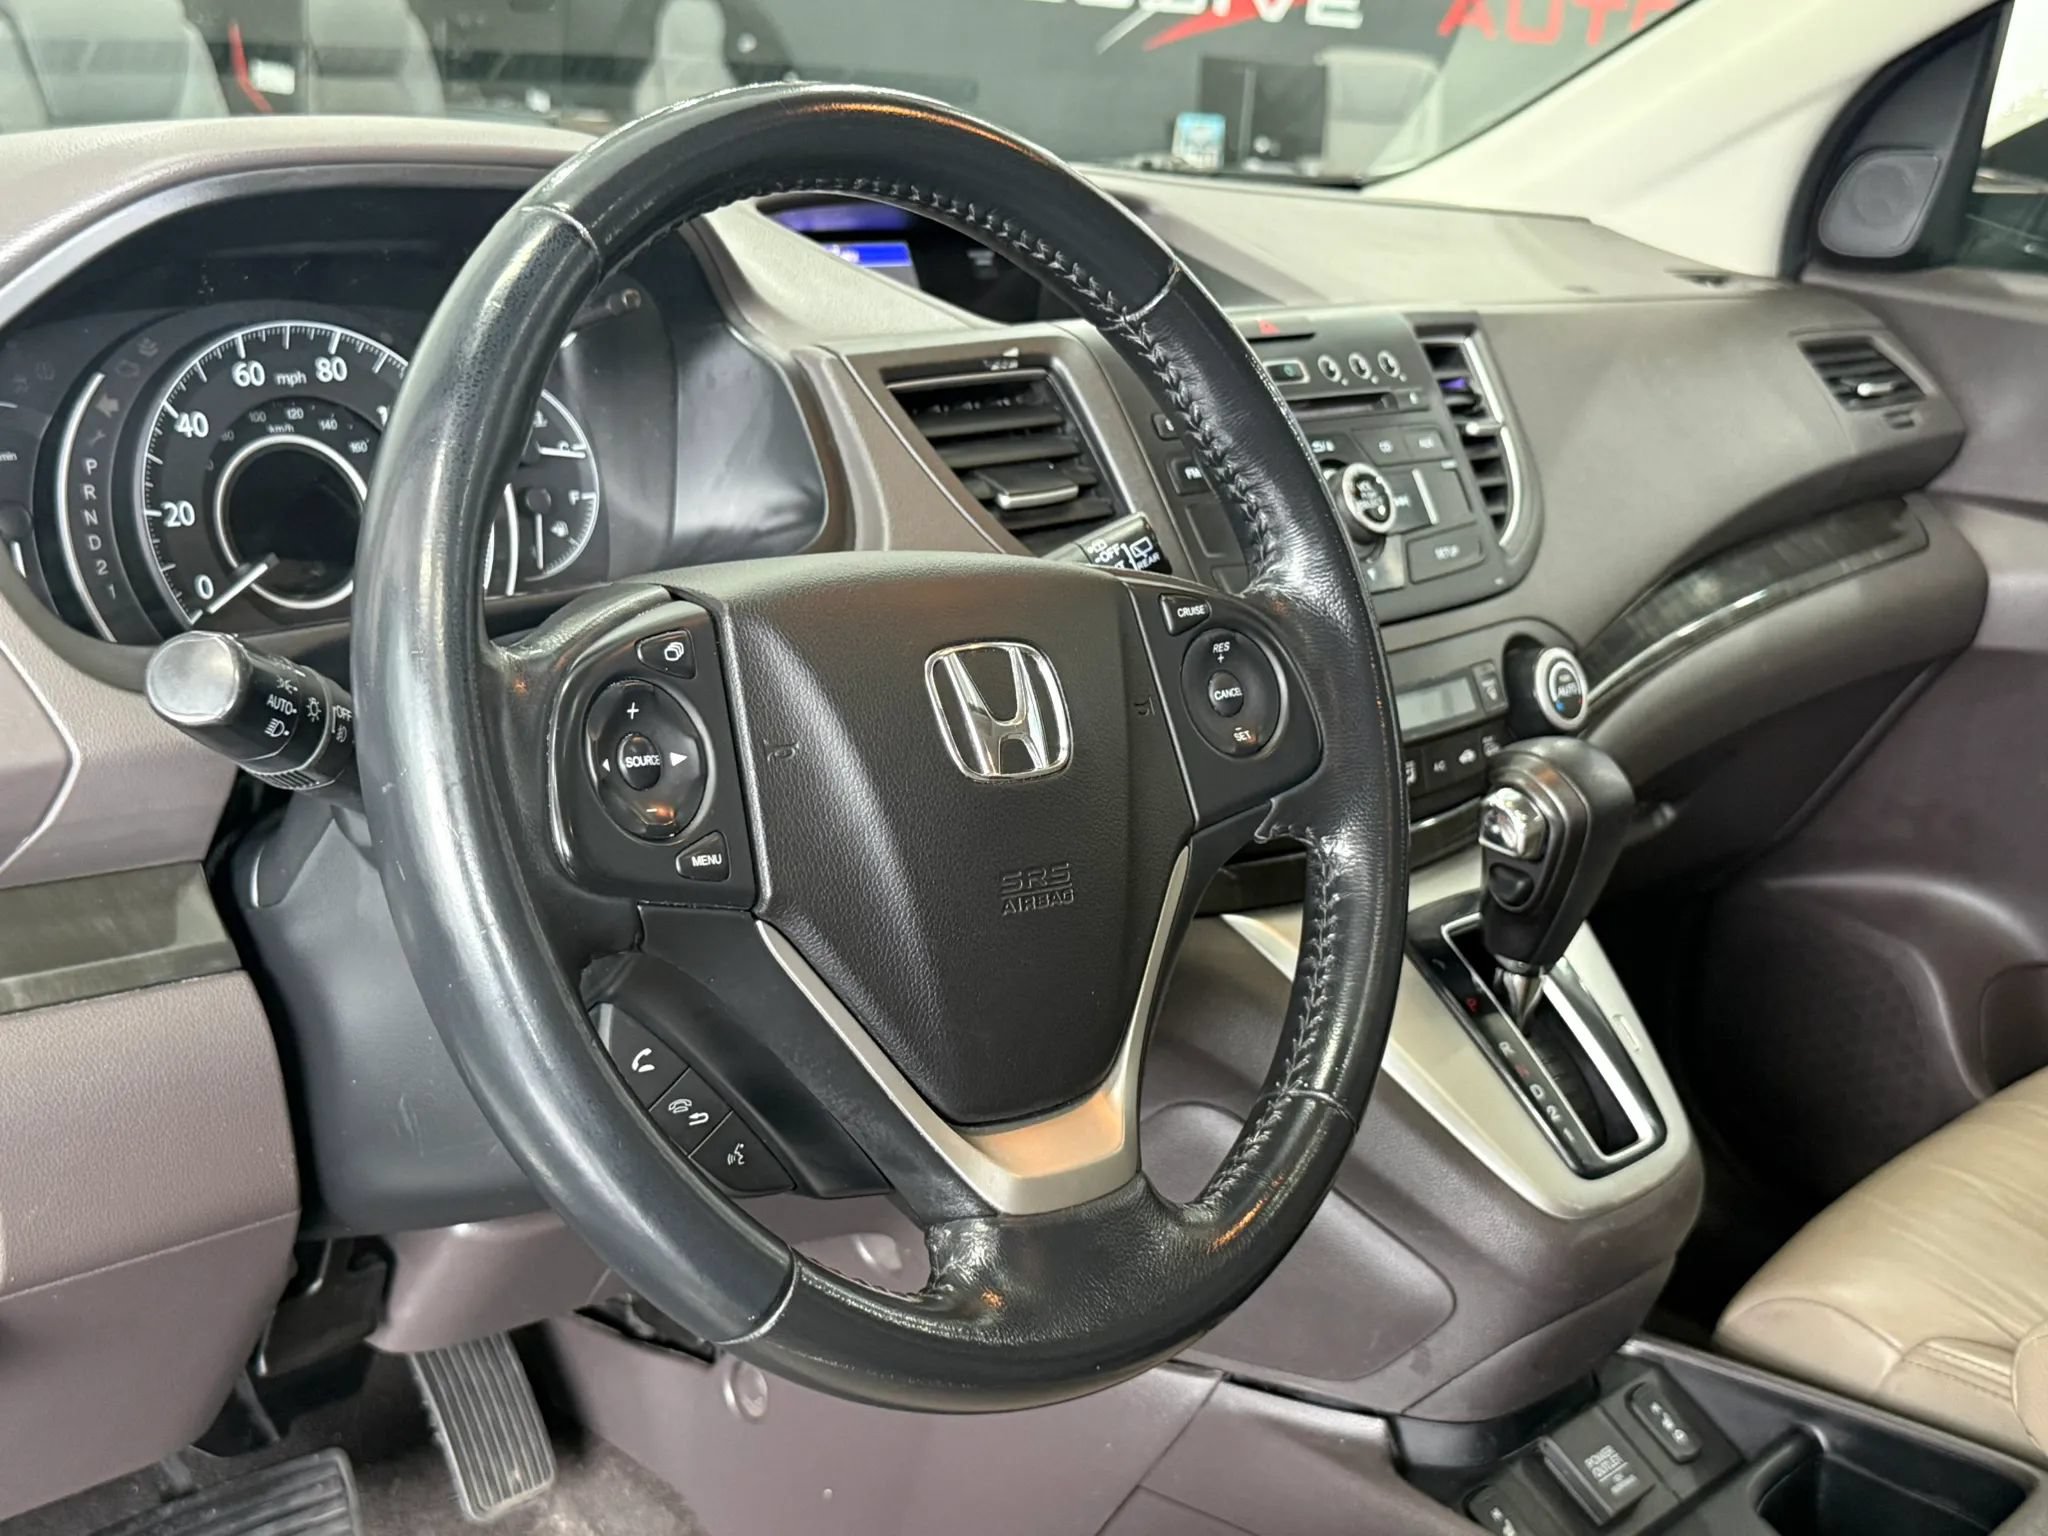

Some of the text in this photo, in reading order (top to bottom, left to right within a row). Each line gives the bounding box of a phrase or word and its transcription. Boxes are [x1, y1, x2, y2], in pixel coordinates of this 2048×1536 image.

[232, 360, 265, 387] 60
[315, 355, 348, 382] 80
[274, 370, 307, 387] mph
[286, 408, 304, 420] 120
[175, 410, 210, 438] 40
[267, 422, 295, 434] km/h
[84, 458, 98, 476] P
[82, 484, 97, 500] R
[83, 509, 99, 526] N
[161, 500, 196, 528] 20
[88, 534, 102, 551] D
[1099, 543, 1121, 563] OFF
[1136, 551, 1161, 571] REAR
[96, 560, 109, 576] 2
[194, 574, 214, 600] 0
[1177, 604, 1206, 618] CRUISE
[1212, 641, 1231, 653] RES
[1214, 687, 1243, 701] CANCEL
[266, 694, 294, 716] AUTO
[335, 705, 352, 722] OFF
[1233, 730, 1252, 742] SET
[624, 755, 661, 768] SOURCE
[691, 854, 722, 868] MENU
[1001, 863, 1071, 894] SRS
[1001, 889, 1074, 917] AIRBAG
[1547, 1105, 1561, 1122] 2
